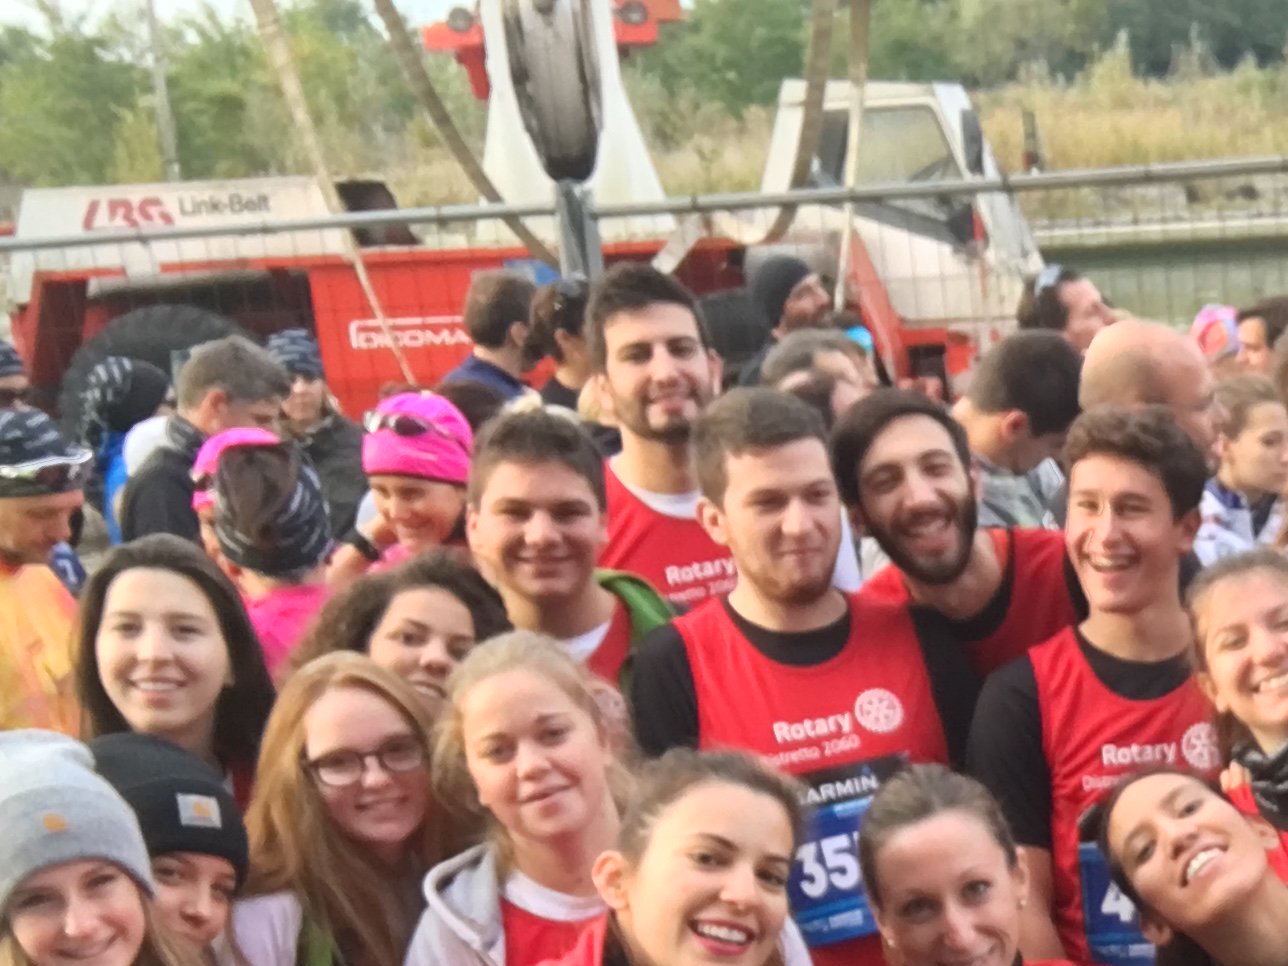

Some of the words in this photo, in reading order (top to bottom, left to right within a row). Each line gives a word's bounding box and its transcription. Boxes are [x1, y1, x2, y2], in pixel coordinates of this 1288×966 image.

[179, 193, 270, 216] Link-Belt
[664, 558, 735, 587] Rotary
[773, 711, 852, 744] Rotary
[822, 733, 861, 758] 2060
[1102, 742, 1177, 767] Rotary
[804, 774, 879, 804] ARMIN
[796, 831, 859, 898] 35
